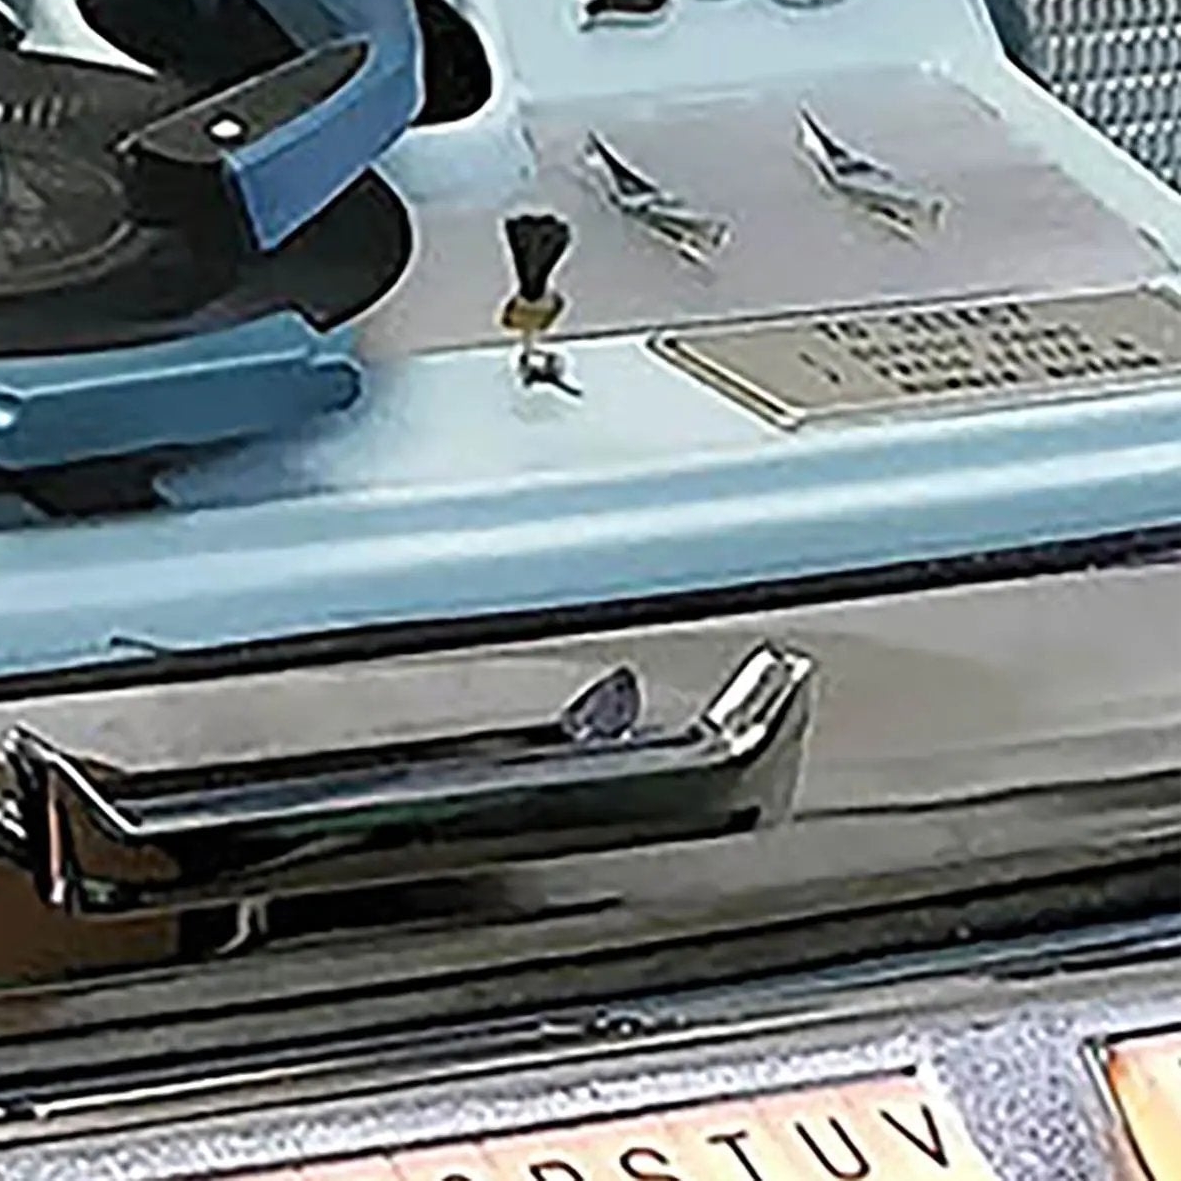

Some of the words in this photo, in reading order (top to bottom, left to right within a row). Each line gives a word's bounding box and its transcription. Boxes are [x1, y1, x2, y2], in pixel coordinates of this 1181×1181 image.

[706, 1130, 764, 1181] T
[795, 1116, 872, 1181] U
[879, 1104, 951, 1168] V
